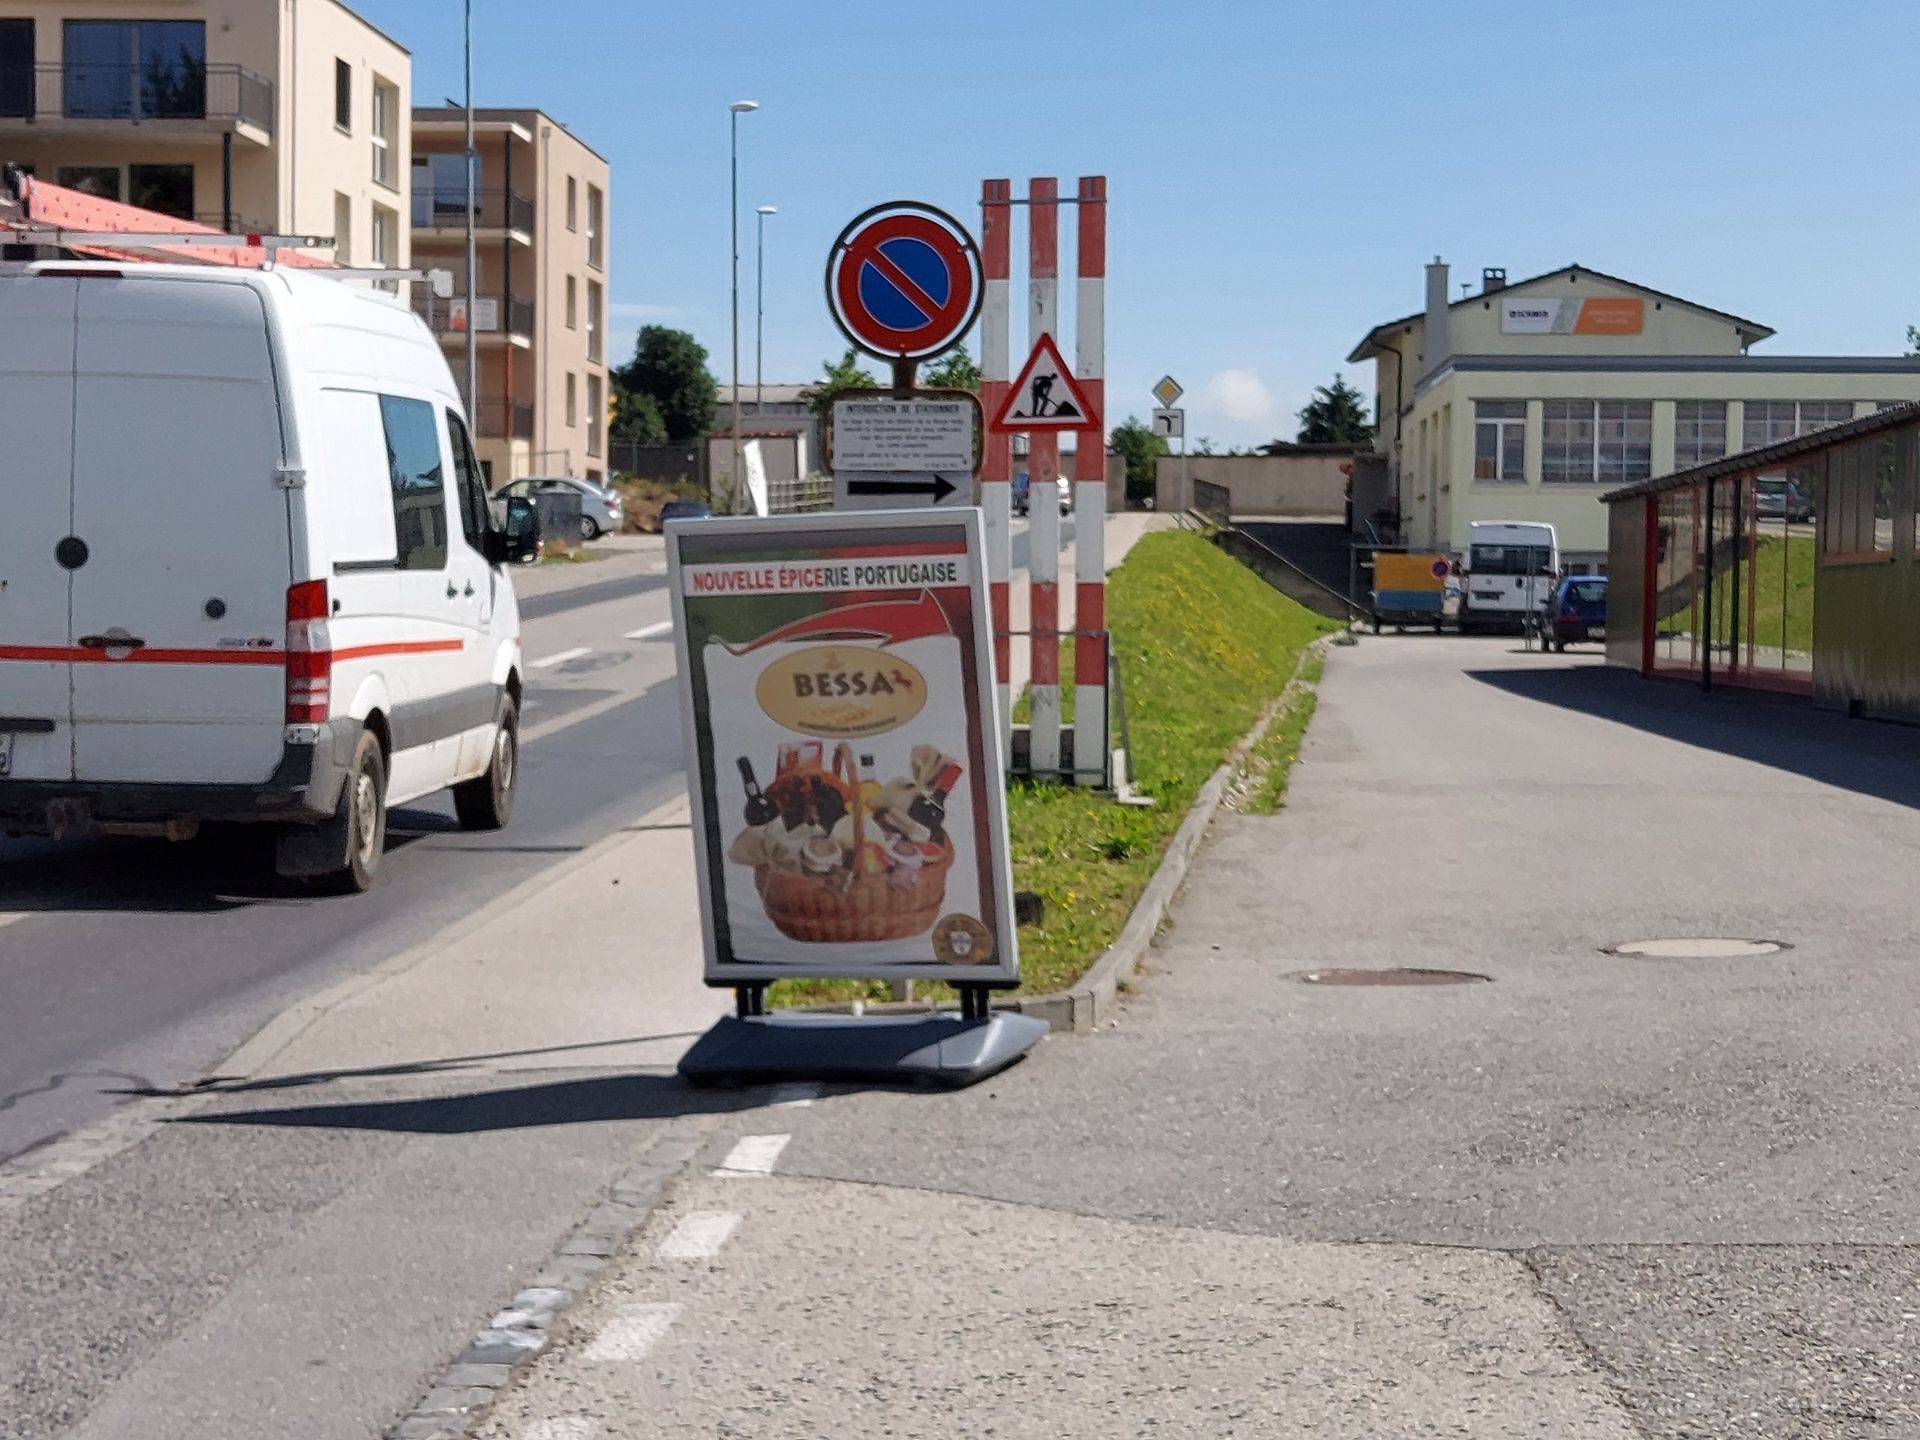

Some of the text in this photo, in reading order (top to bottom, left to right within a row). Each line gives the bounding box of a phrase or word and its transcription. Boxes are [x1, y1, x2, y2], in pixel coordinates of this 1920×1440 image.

[693, 562, 957, 591] NOUVELLE ÉPICERIE PORTUGAISE
[792, 671, 895, 699] BESSA
